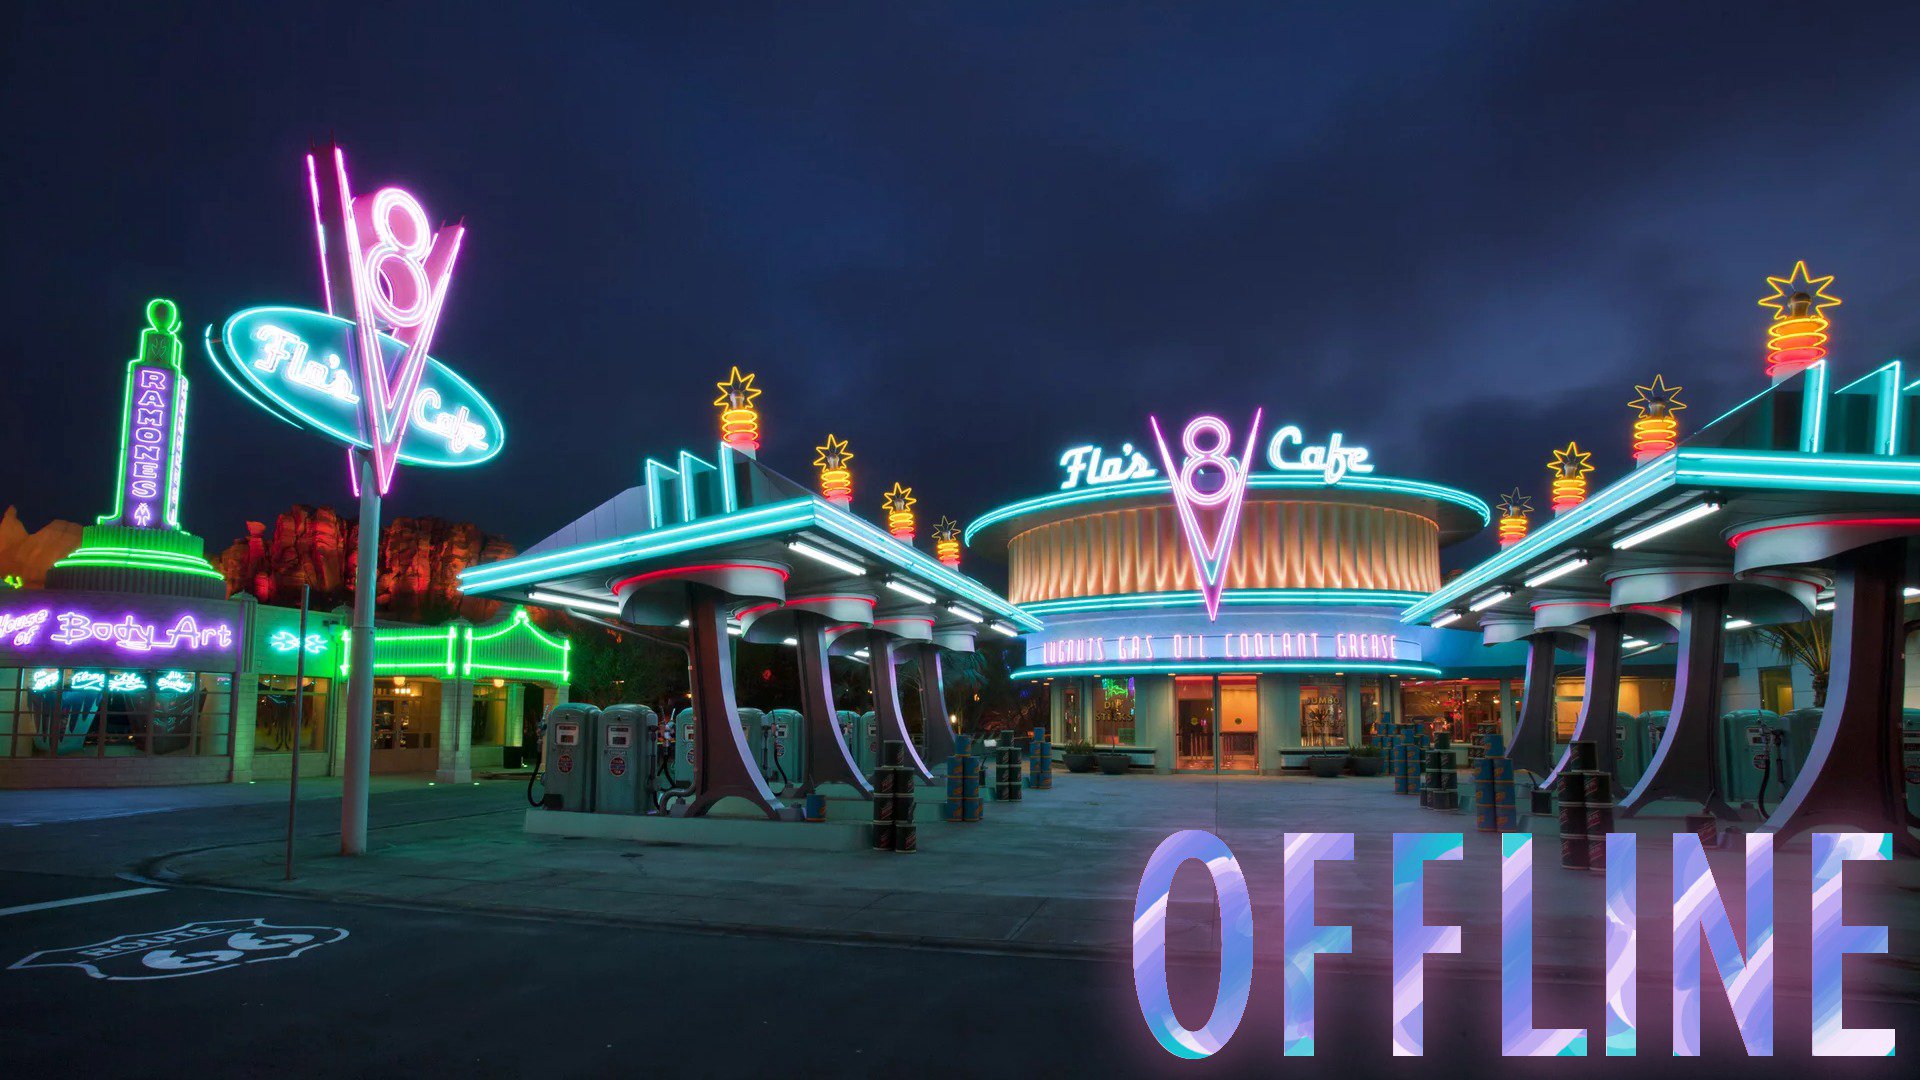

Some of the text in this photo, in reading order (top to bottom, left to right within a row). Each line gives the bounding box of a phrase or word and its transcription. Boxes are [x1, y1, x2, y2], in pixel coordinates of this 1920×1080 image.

[254, 325, 361, 405] Flo's
[412, 387, 490, 453] Cafe
[131, 369, 167, 498] RAMONES
[1059, 443, 1158, 490] Flo's
[1267, 425, 1376, 485] Cafe
[14, 624, 40, 646] of
[50, 611, 233, 651] Body Art
[1043, 632, 1398, 665] LUGNUTS GAS OIL COOLANT GREASE
[77, 926, 227, 958] ROUTE
[141, 932, 315, 970] 66
